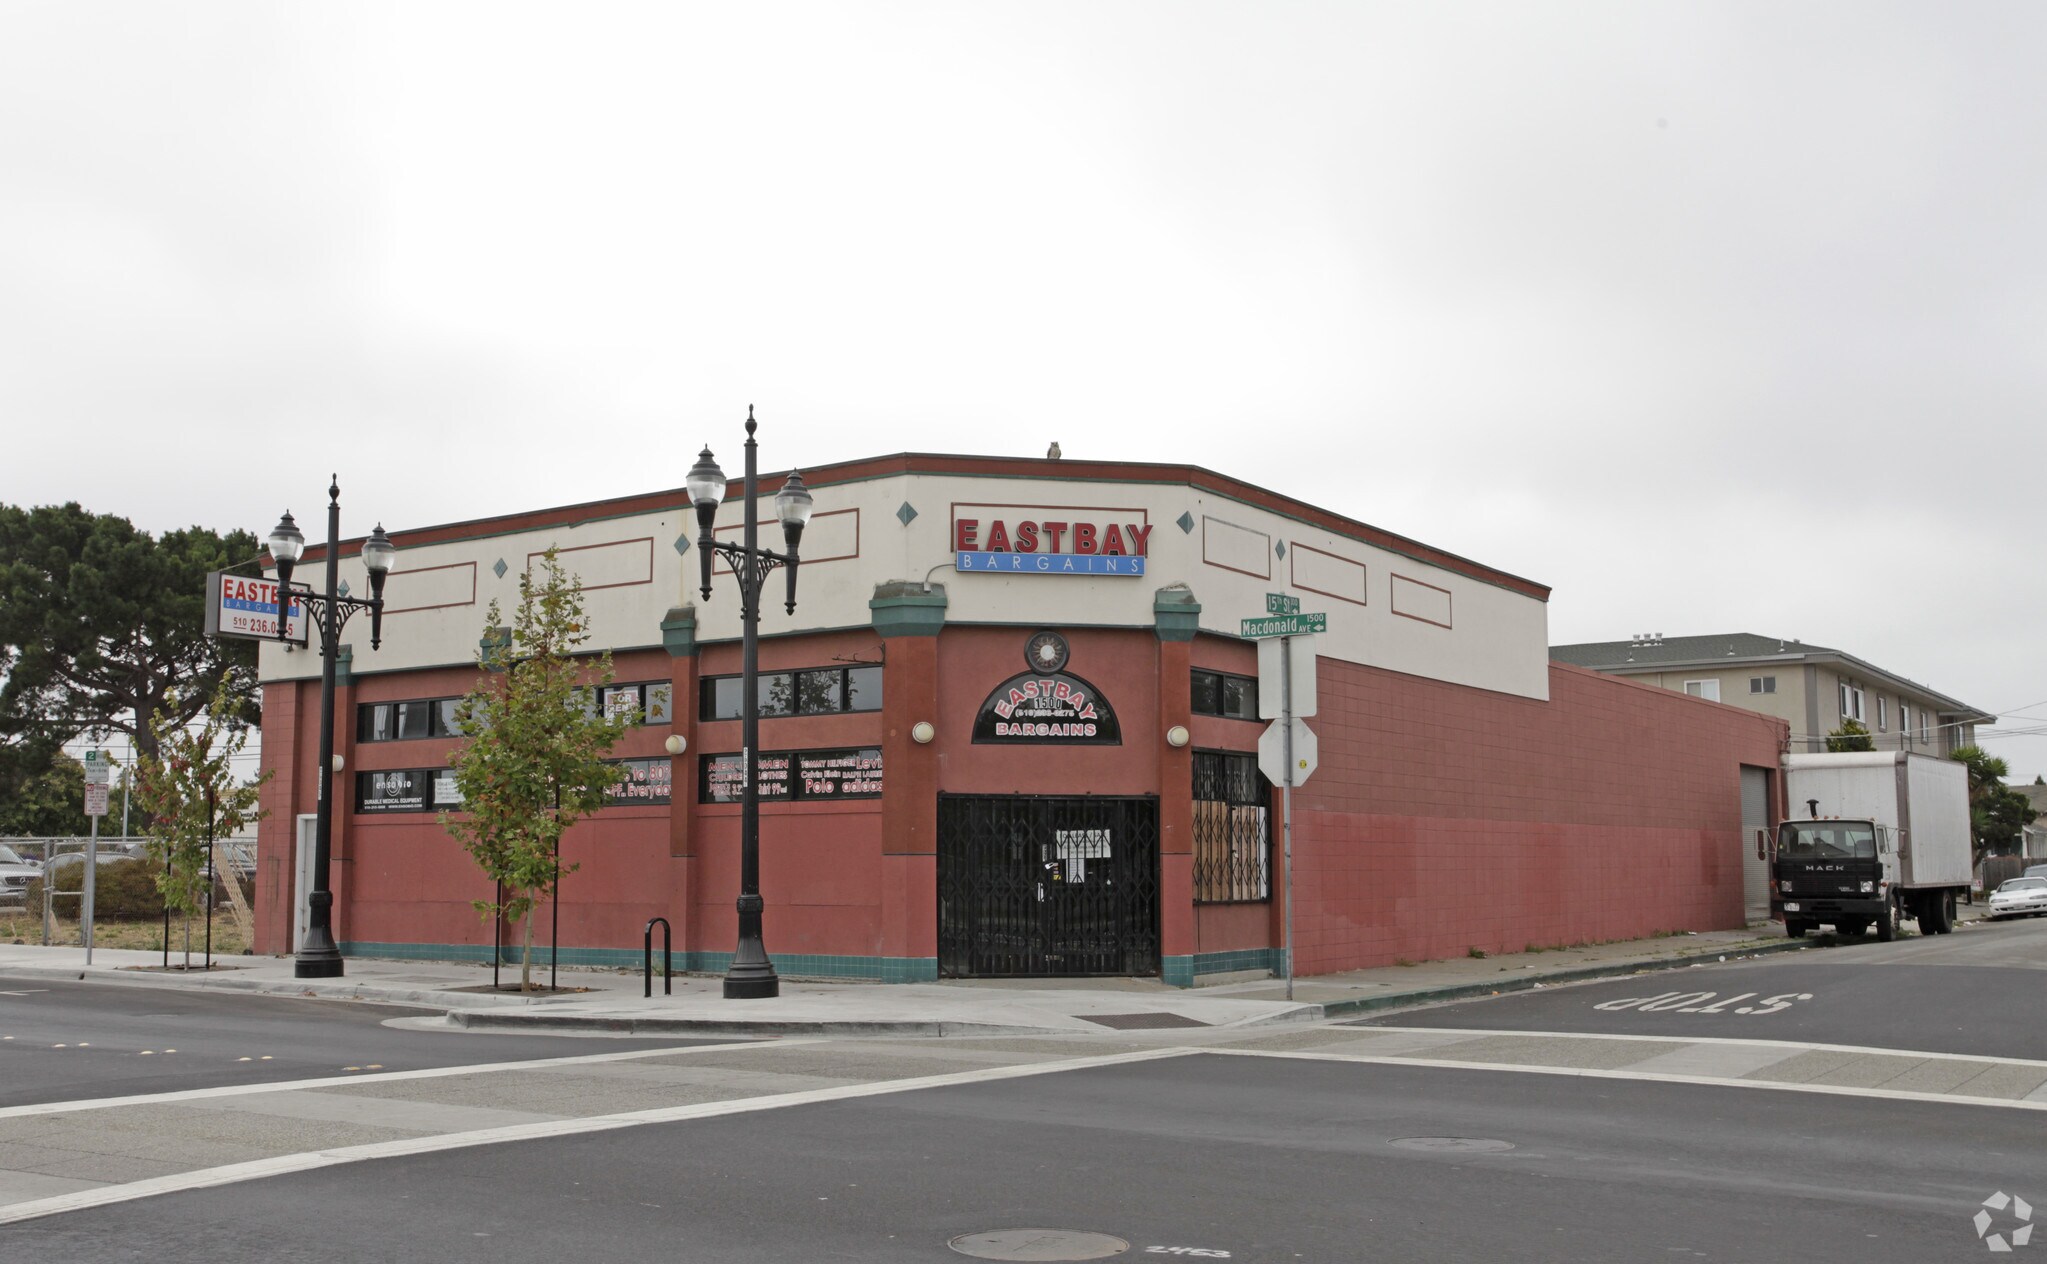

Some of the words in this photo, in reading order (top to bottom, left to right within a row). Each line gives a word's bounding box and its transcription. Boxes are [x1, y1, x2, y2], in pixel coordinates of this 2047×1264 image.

[957, 519, 1153, 556] EASTBAY
[963, 555, 1139, 572] BARGAINS
[1307, 614, 1324, 622] 1500
[233, 617, 247, 627] 510
[250, 618, 293, 636] 236.05
[1242, 618, 1297, 635] Macdonald
[1299, 624, 1311, 633] AVE
[994, 680, 1097, 719] EASTBAY
[1034, 697, 1061, 709] 1500
[995, 722, 1097, 736] BARGAINS
[856, 756, 882, 770] Levi
[633, 767, 645, 781] to
[758, 771, 788, 780] LOTHES
[805, 778, 834, 794] Polo
[1593, 991, 1814, 1015] STOP
